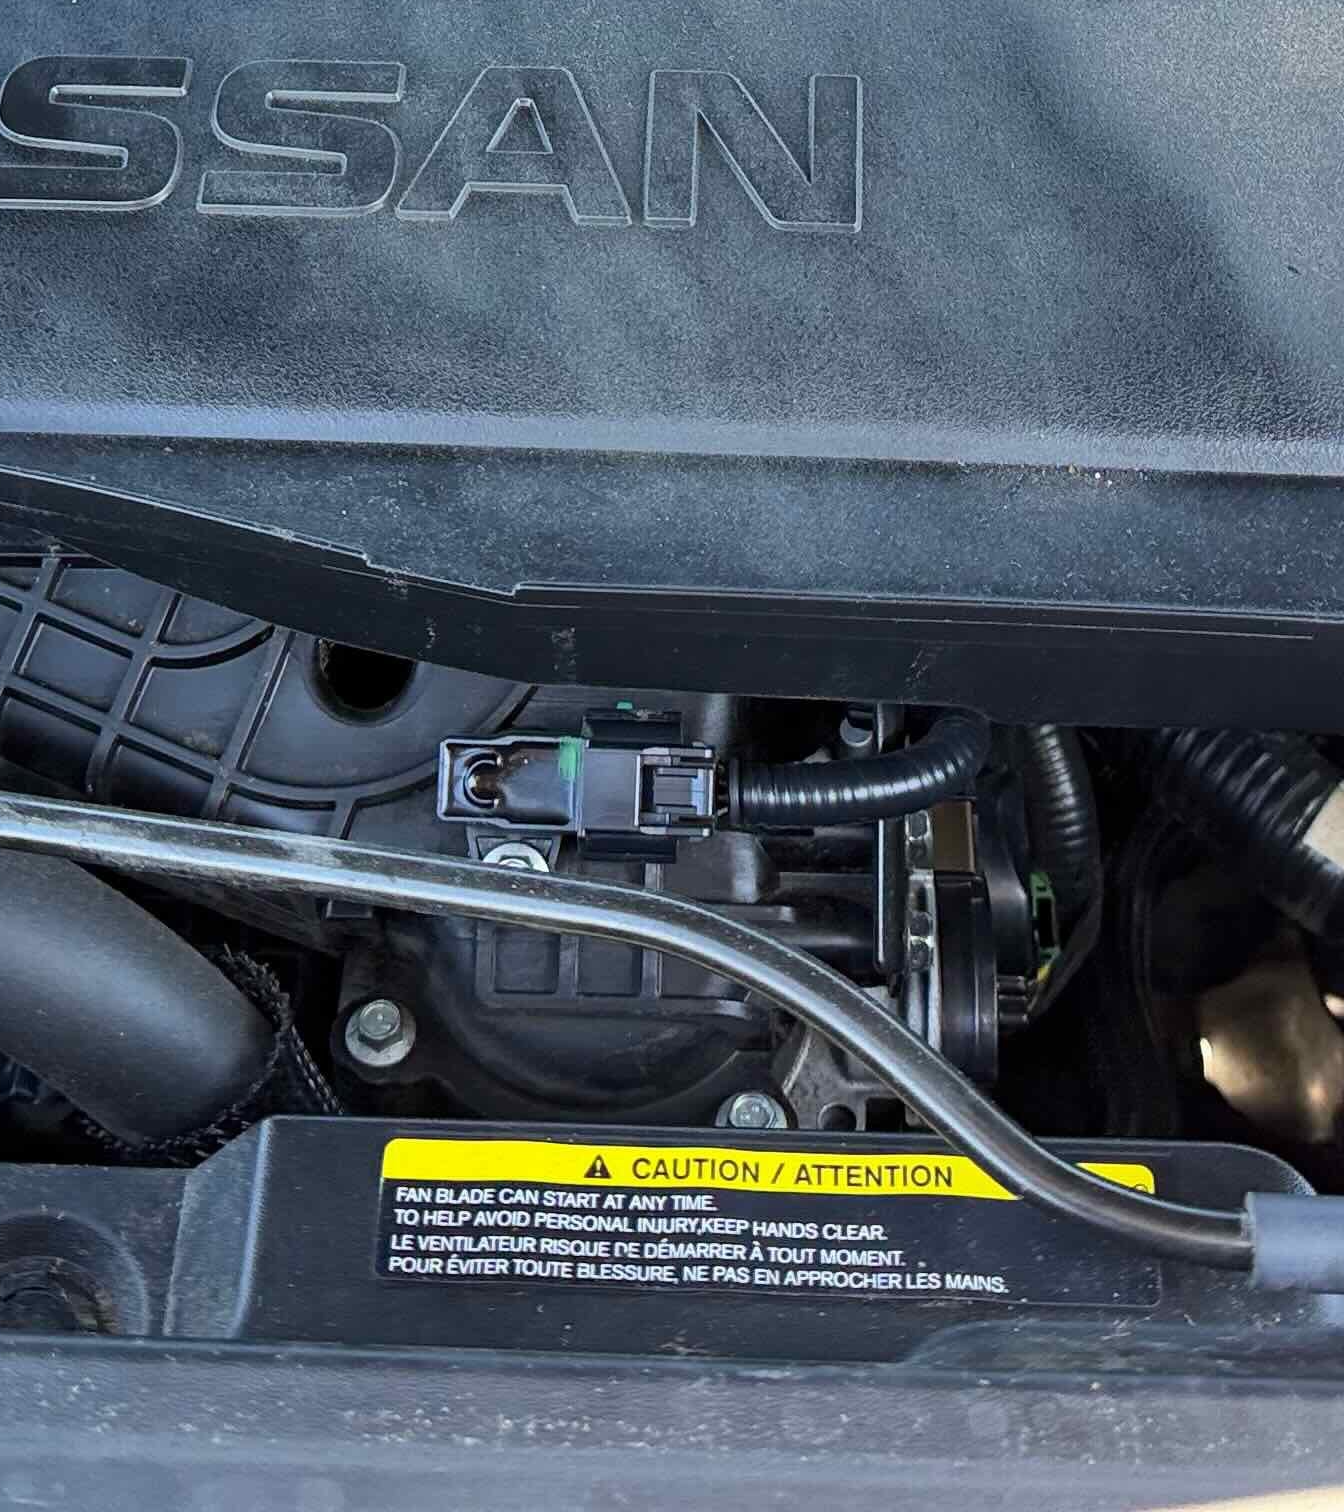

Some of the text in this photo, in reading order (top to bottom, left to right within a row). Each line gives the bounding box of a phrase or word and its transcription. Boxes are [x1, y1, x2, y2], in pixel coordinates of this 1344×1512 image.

[632, 1158, 759, 1183] CAUTION
[794, 1163, 953, 1187] ATTENTION
[395, 1187, 718, 1212] FAN BLADE CAN START AT ANY TIME.
[394, 1209, 418, 1225] TO
[422, 1210, 472, 1227] HELP
[474, 1211, 530, 1228] AVOID
[534, 1212, 634, 1233] PERSONAL
[752, 1222, 818, 1239] HANDS
[822, 1223, 888, 1240] CLEAR.
[391, 1235, 906, 1267] LE VENTILATEUR RISQUE DE DÉMARRER À TOUT MOMENT.
[388, 1254, 1010, 1293] POUR ÉVITER TOUTE BLESSURE, NE PAS EN APPROCHER LES MAINS.
